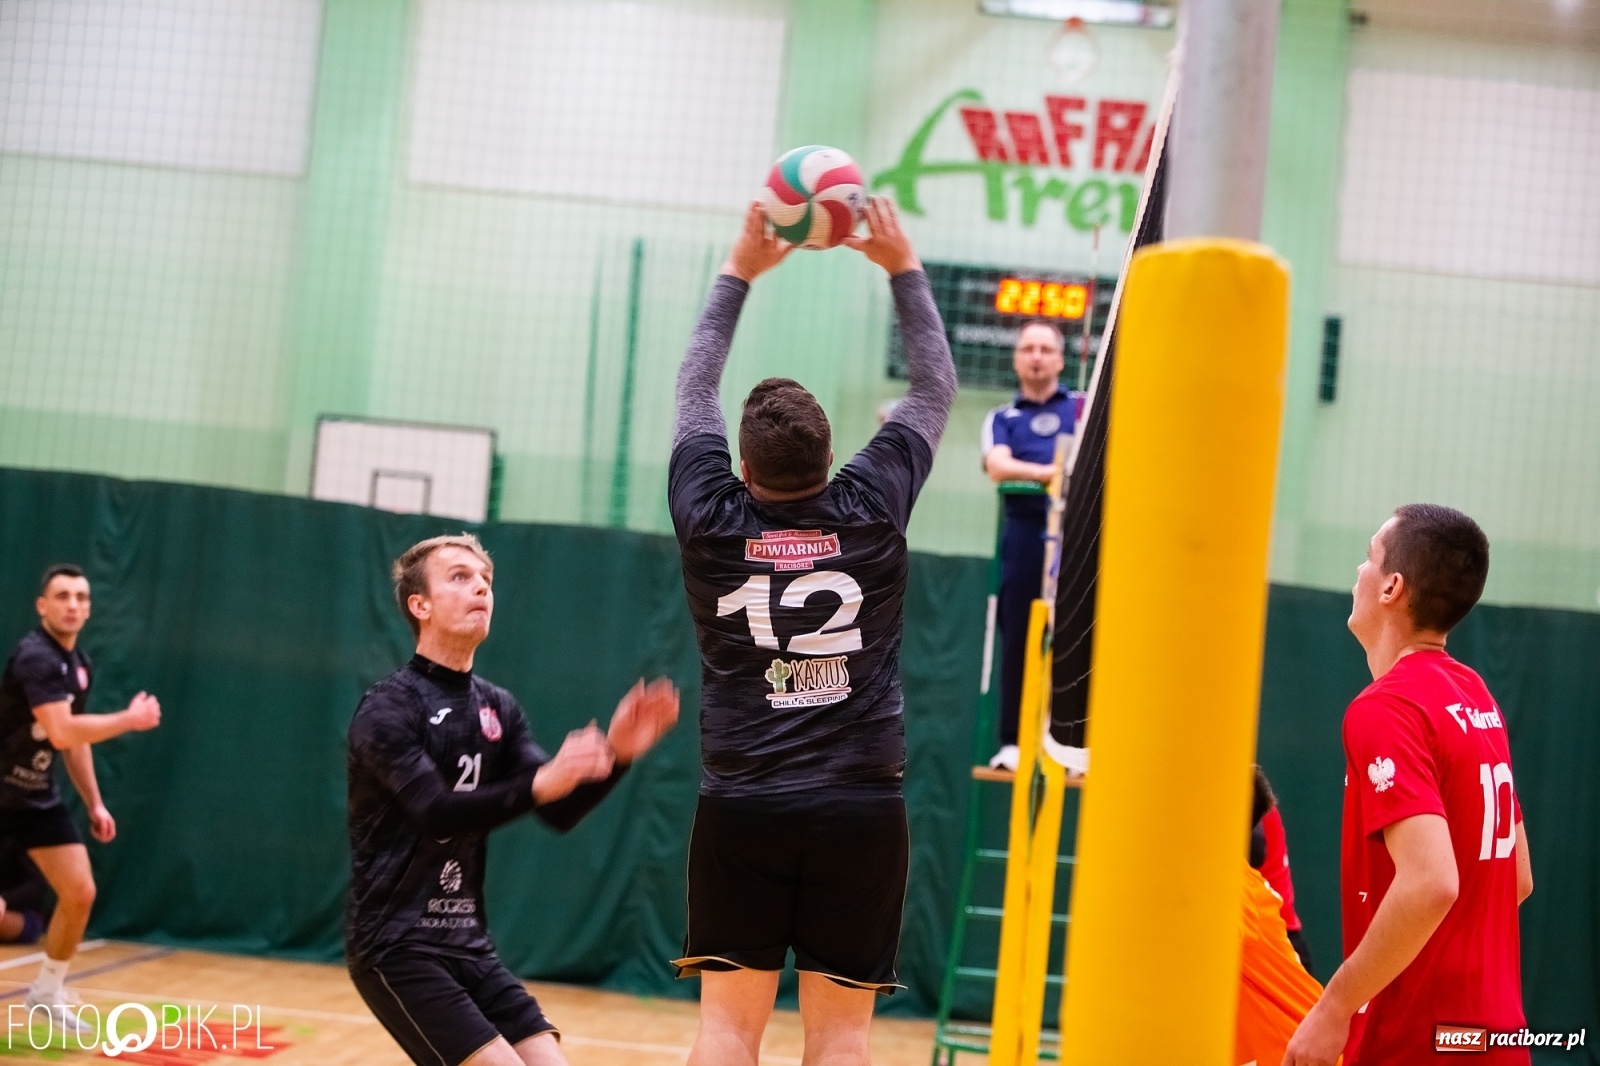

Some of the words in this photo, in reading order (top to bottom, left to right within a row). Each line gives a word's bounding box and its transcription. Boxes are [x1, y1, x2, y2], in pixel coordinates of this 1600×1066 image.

[752, 540, 834, 556] PIWIARNIA
[716, 571, 864, 655] 12
[792, 656, 848, 691] KAKTUS
[453, 753, 482, 792] 21
[1479, 762, 1516, 860] 10
